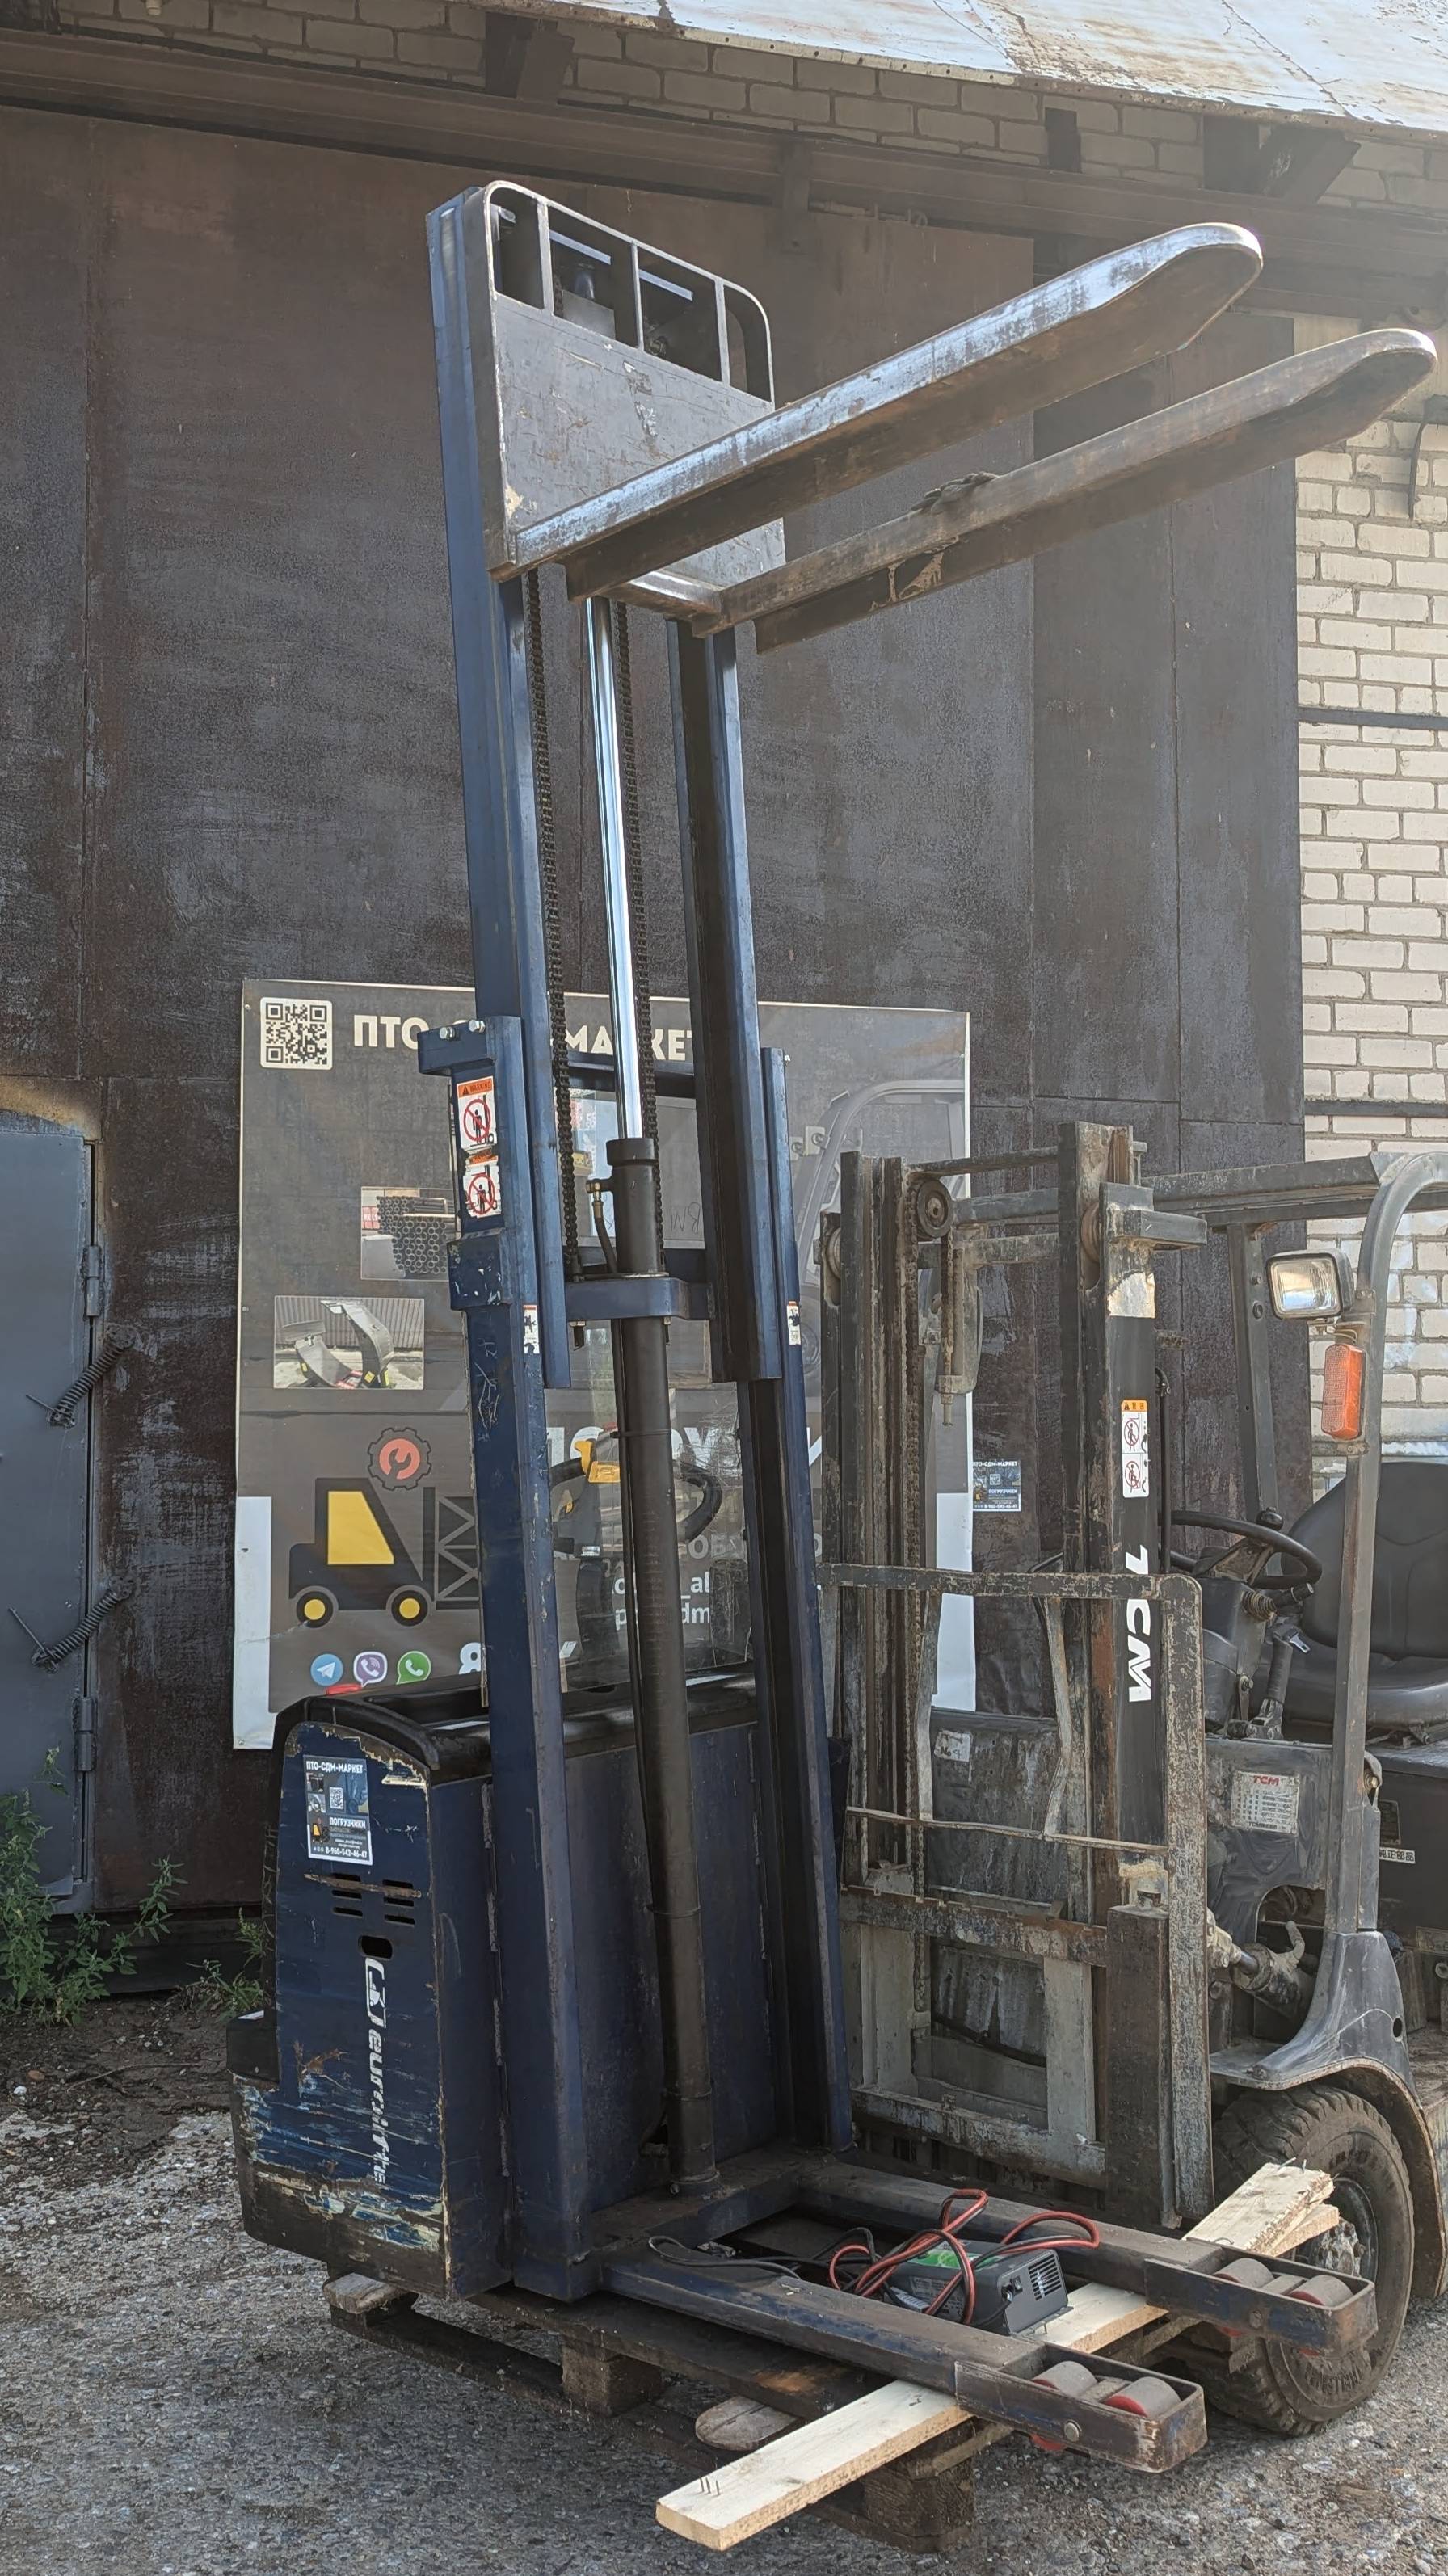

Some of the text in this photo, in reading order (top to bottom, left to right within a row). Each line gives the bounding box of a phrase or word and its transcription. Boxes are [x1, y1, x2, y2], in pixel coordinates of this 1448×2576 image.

[1125, 1544, 1152, 1703] TCM
[305, 1760, 364, 1774] ПТО-СДМ-МАРКЕТ
[1252, 1774, 1280, 1786] TCM
[329, 1816, 367, 1829] ПОГРУЗЧИКИ
